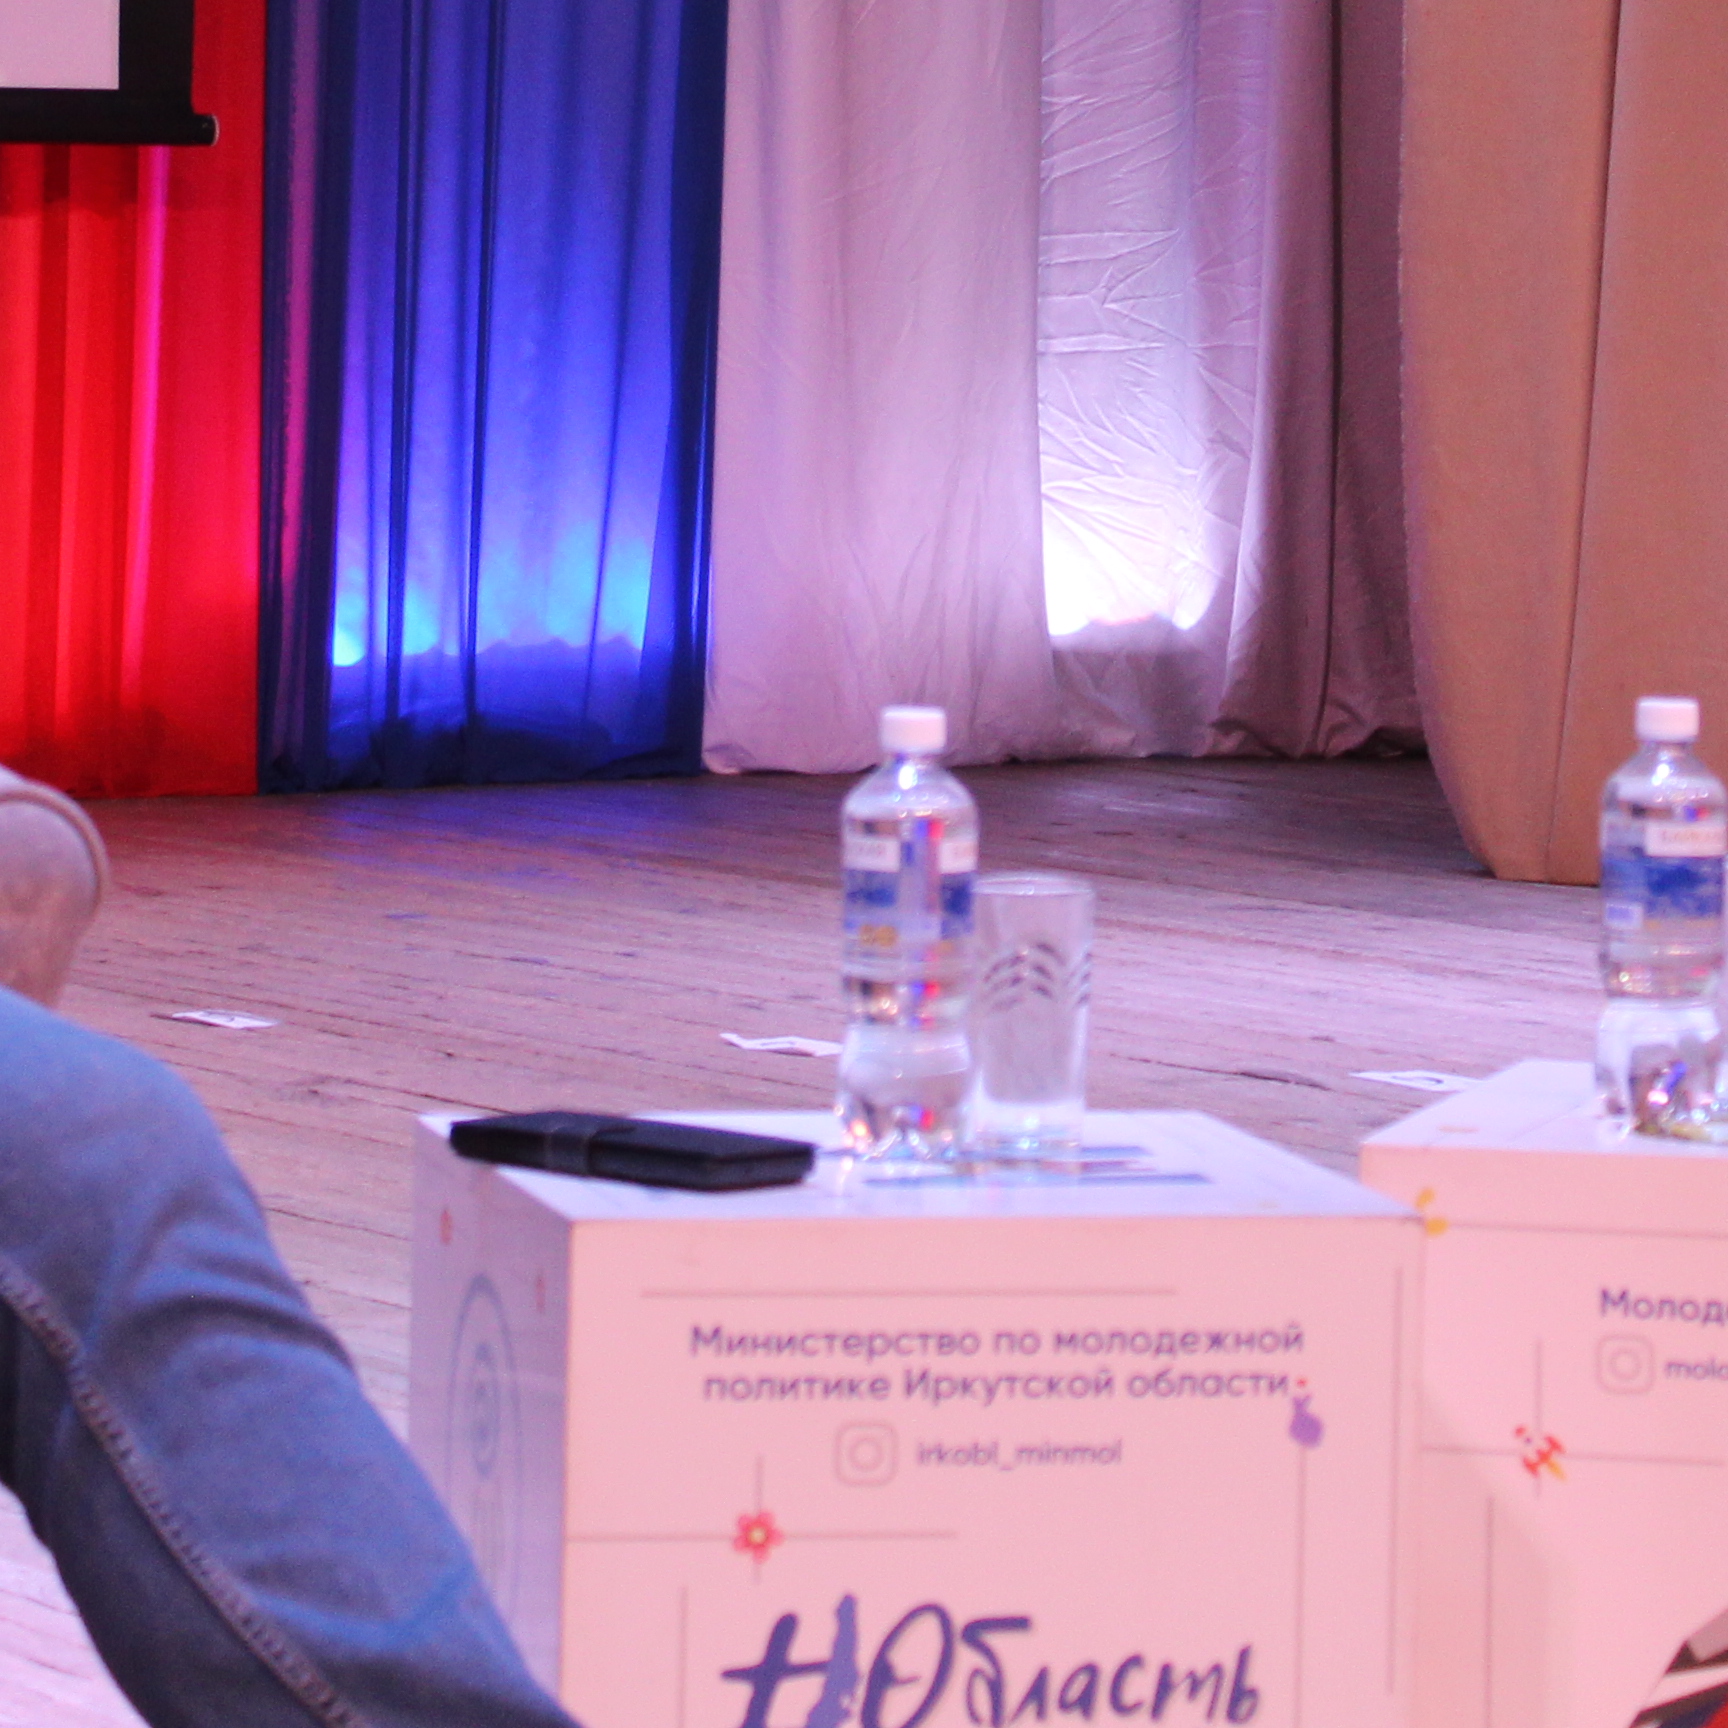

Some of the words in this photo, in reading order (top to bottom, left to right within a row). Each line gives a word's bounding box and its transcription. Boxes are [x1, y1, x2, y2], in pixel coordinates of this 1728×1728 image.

[689, 1325, 981, 1364] Министерство
[993, 1330, 1041, 1356] по
[1053, 1321, 1304, 1360] молодежной
[703, 1376, 892, 1401] политике
[903, 1367, 1114, 1407] Иркутской
[1127, 1368, 1289, 1399] области
